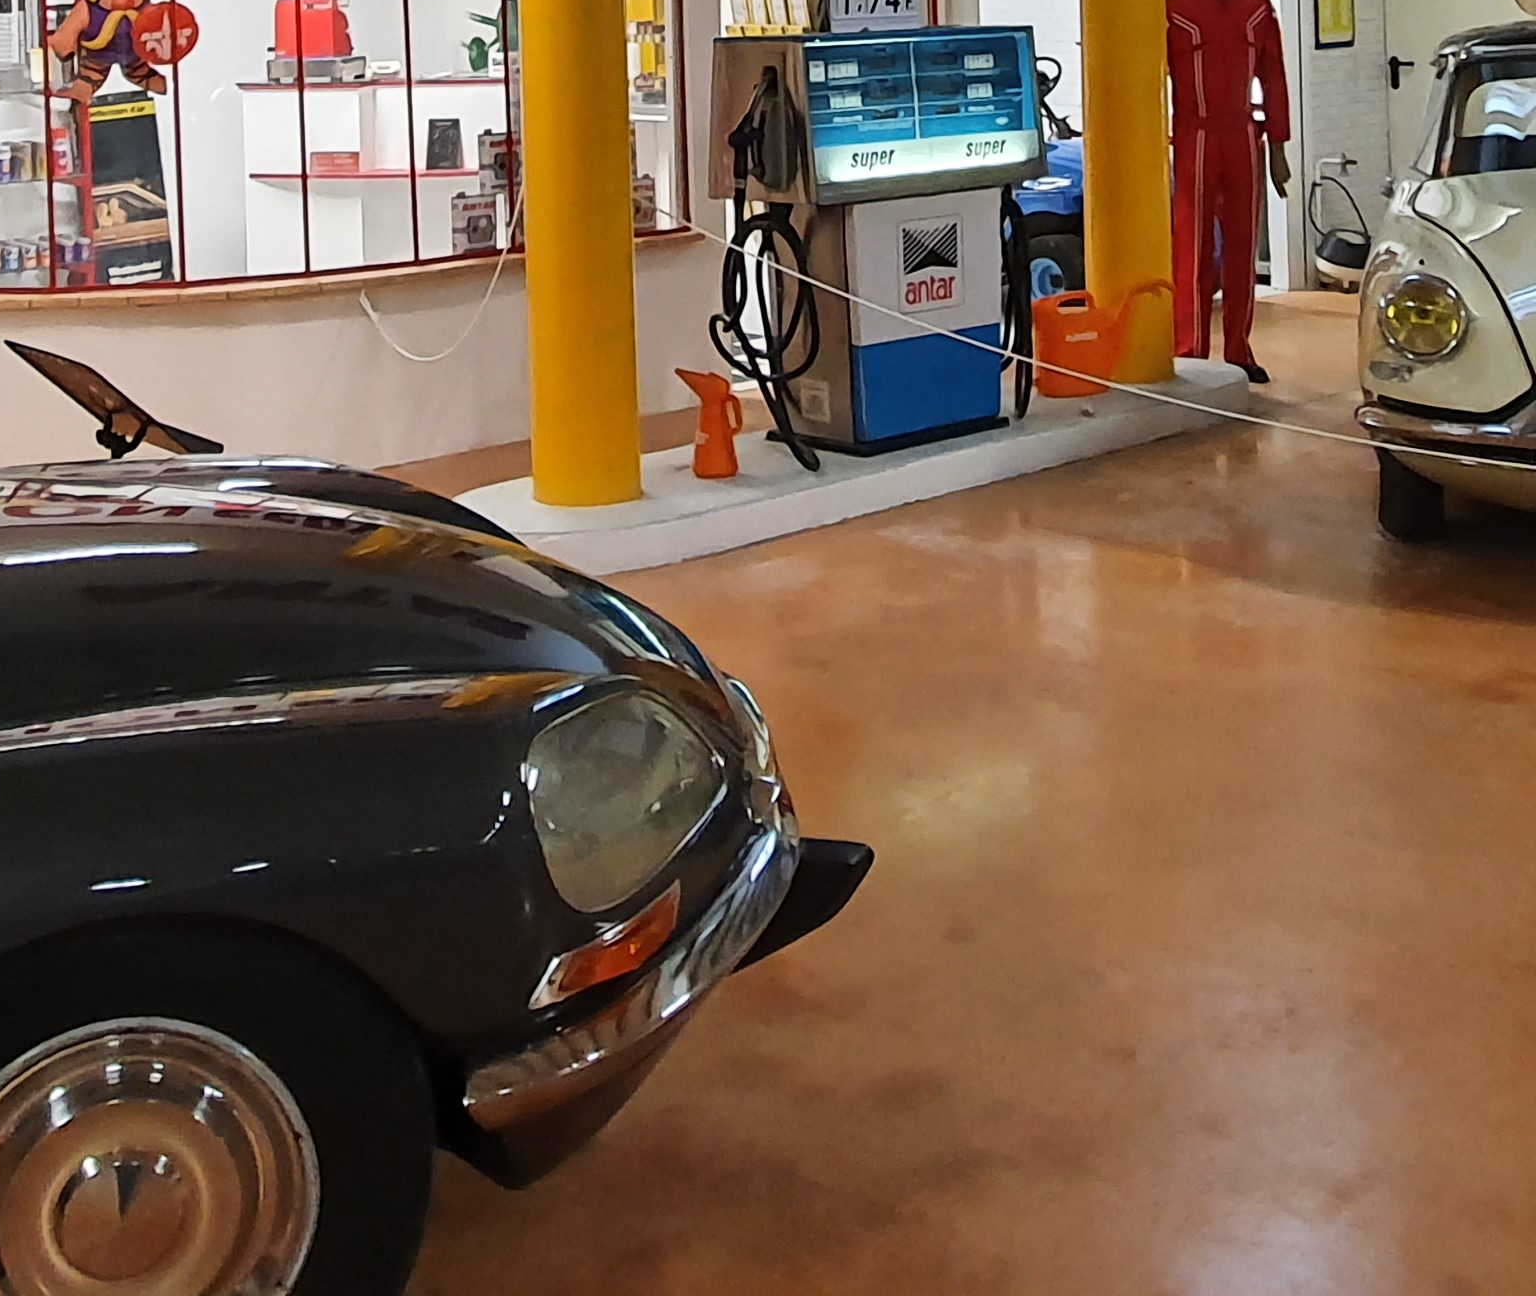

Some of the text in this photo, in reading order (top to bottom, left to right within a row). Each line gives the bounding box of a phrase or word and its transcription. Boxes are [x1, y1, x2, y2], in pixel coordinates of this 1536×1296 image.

[850, 149, 896, 171] super
[965, 139, 1007, 159] super
[904, 275, 956, 305] antar
